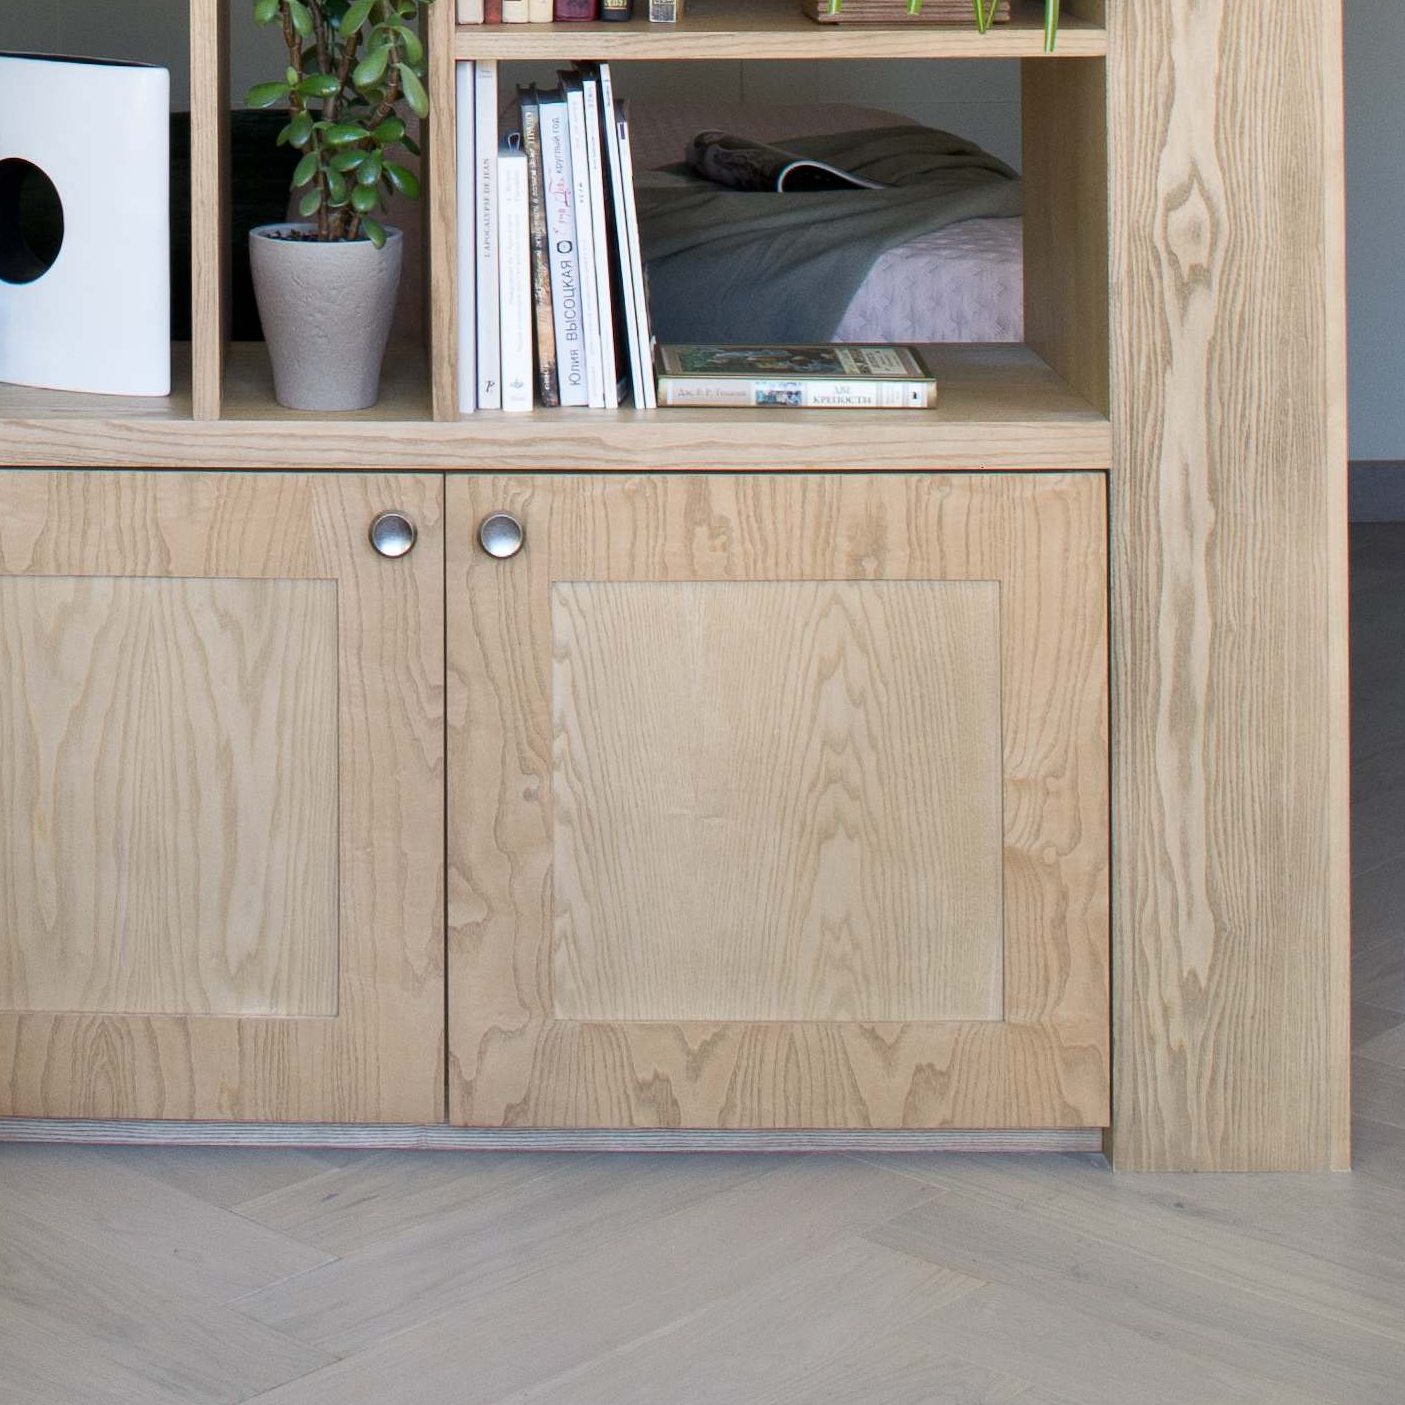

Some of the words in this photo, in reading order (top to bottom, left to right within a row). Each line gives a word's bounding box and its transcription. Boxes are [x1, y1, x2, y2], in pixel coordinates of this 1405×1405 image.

[550, 116, 562, 135] год
[560, 258, 579, 342] ВЫСОЦКАЯ
[567, 348, 583, 387] Юлия
